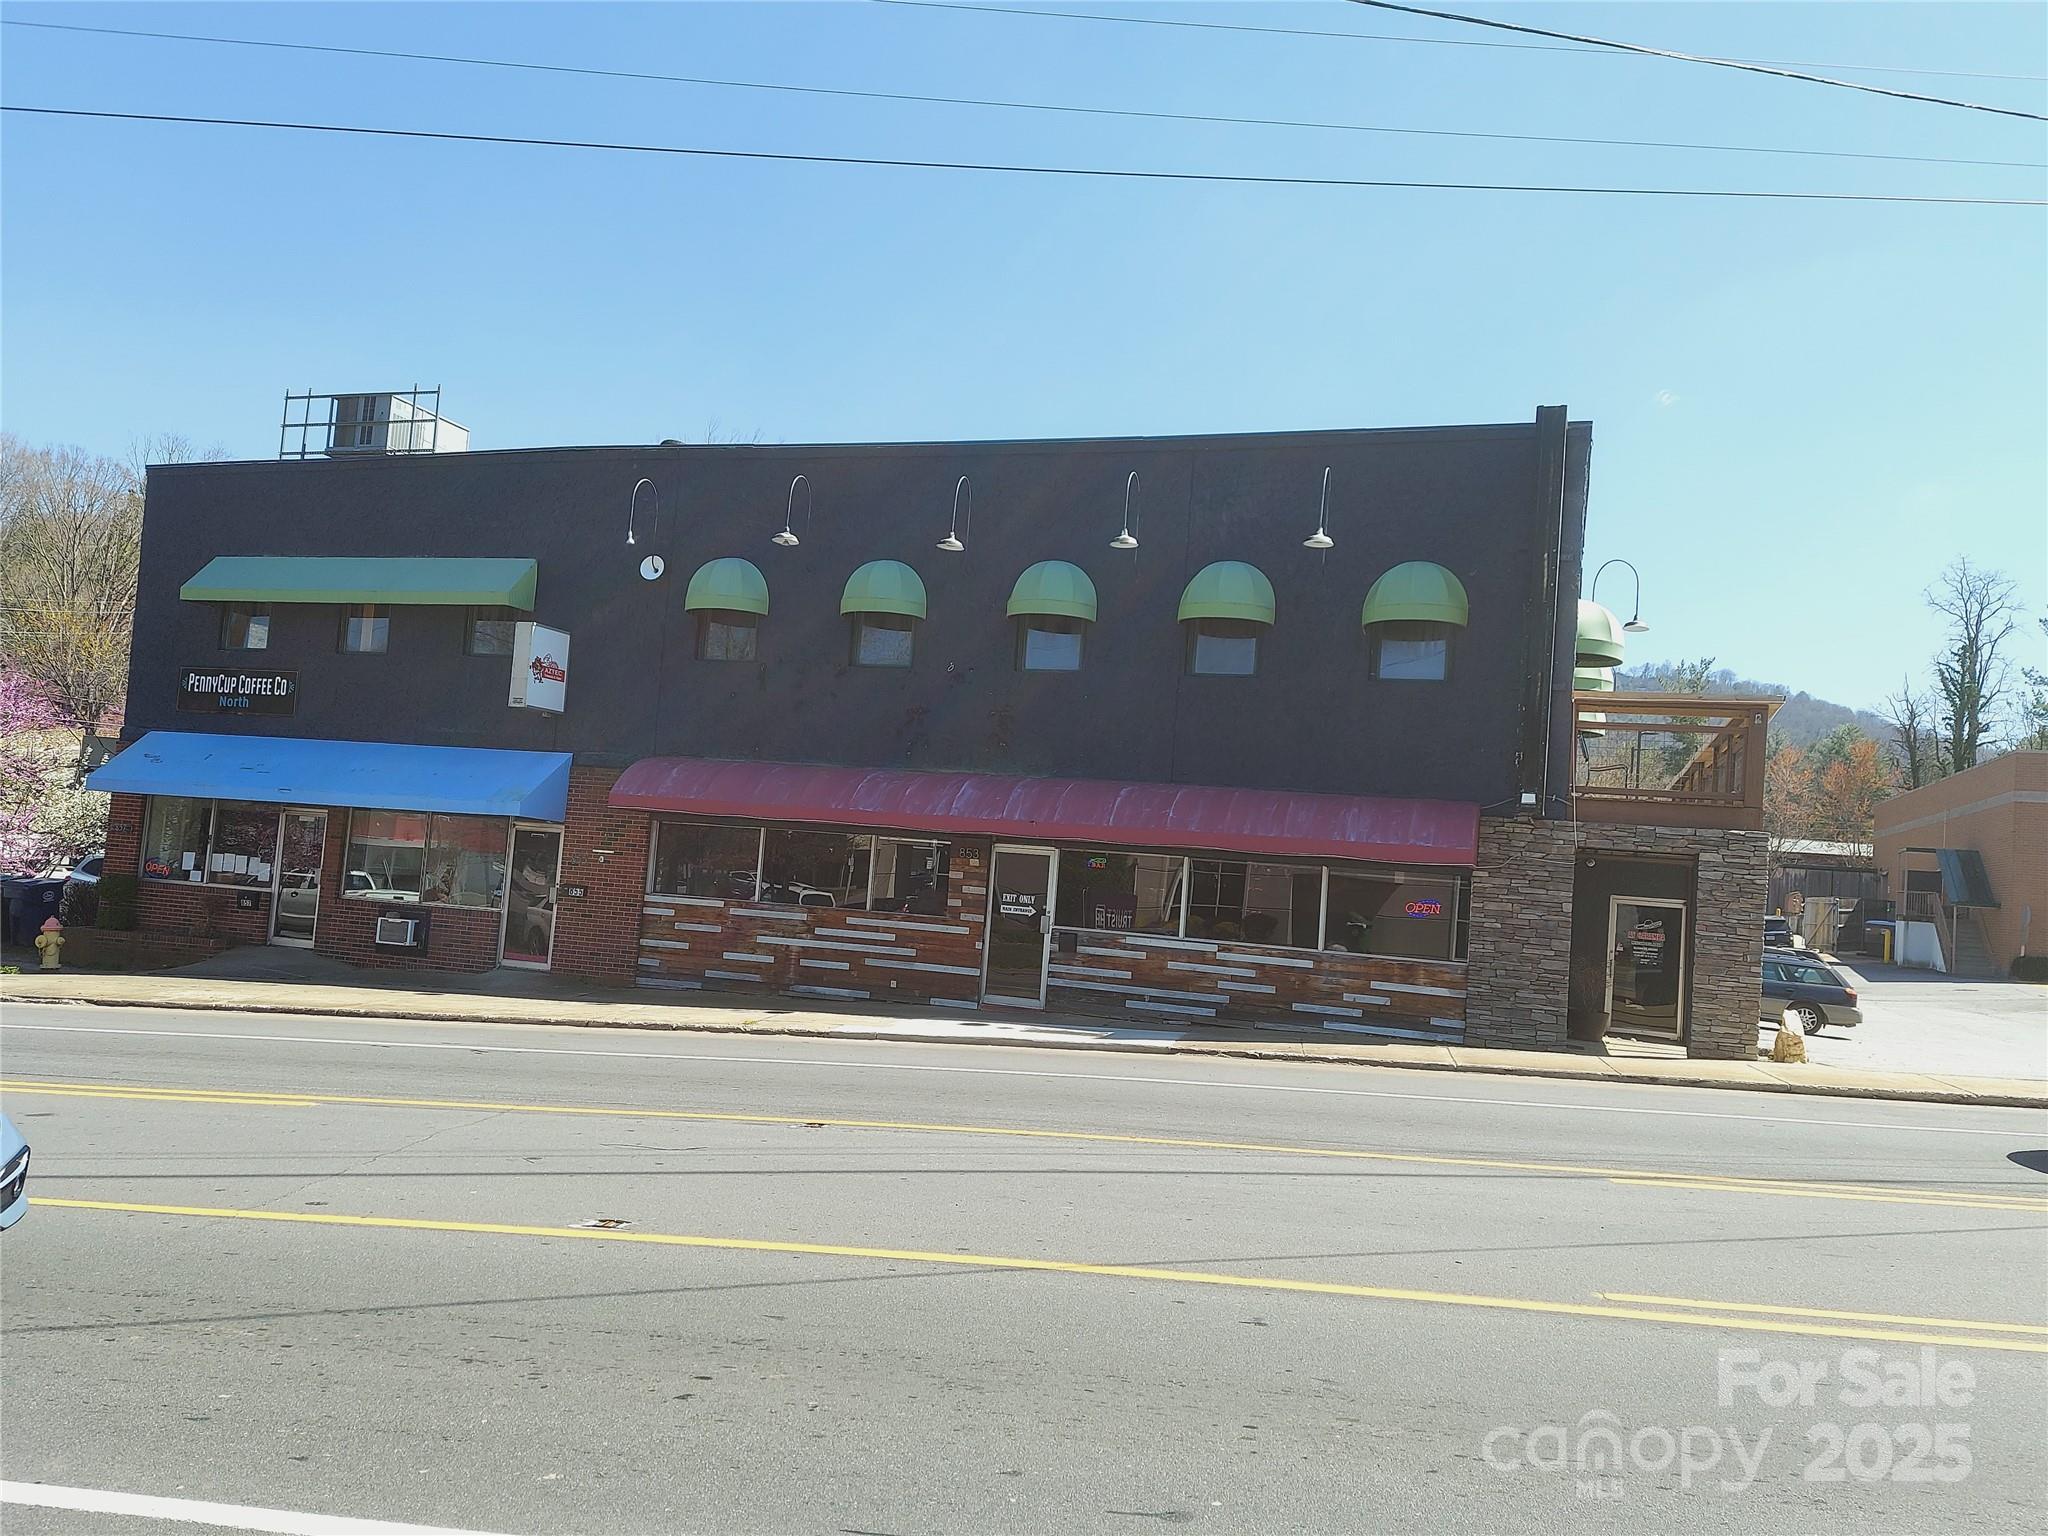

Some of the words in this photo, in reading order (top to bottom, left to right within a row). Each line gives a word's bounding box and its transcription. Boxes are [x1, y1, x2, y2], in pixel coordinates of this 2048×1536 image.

[238, 675, 273, 695] COFFEE
[219, 696, 249, 708] North
[960, 848, 980, 859] 853
[145, 861, 170, 876] OPEN
[1003, 893, 1018, 903] EXIT
[1019, 894, 1036, 905] ONLY
[1405, 902, 1441, 914] OPEN
